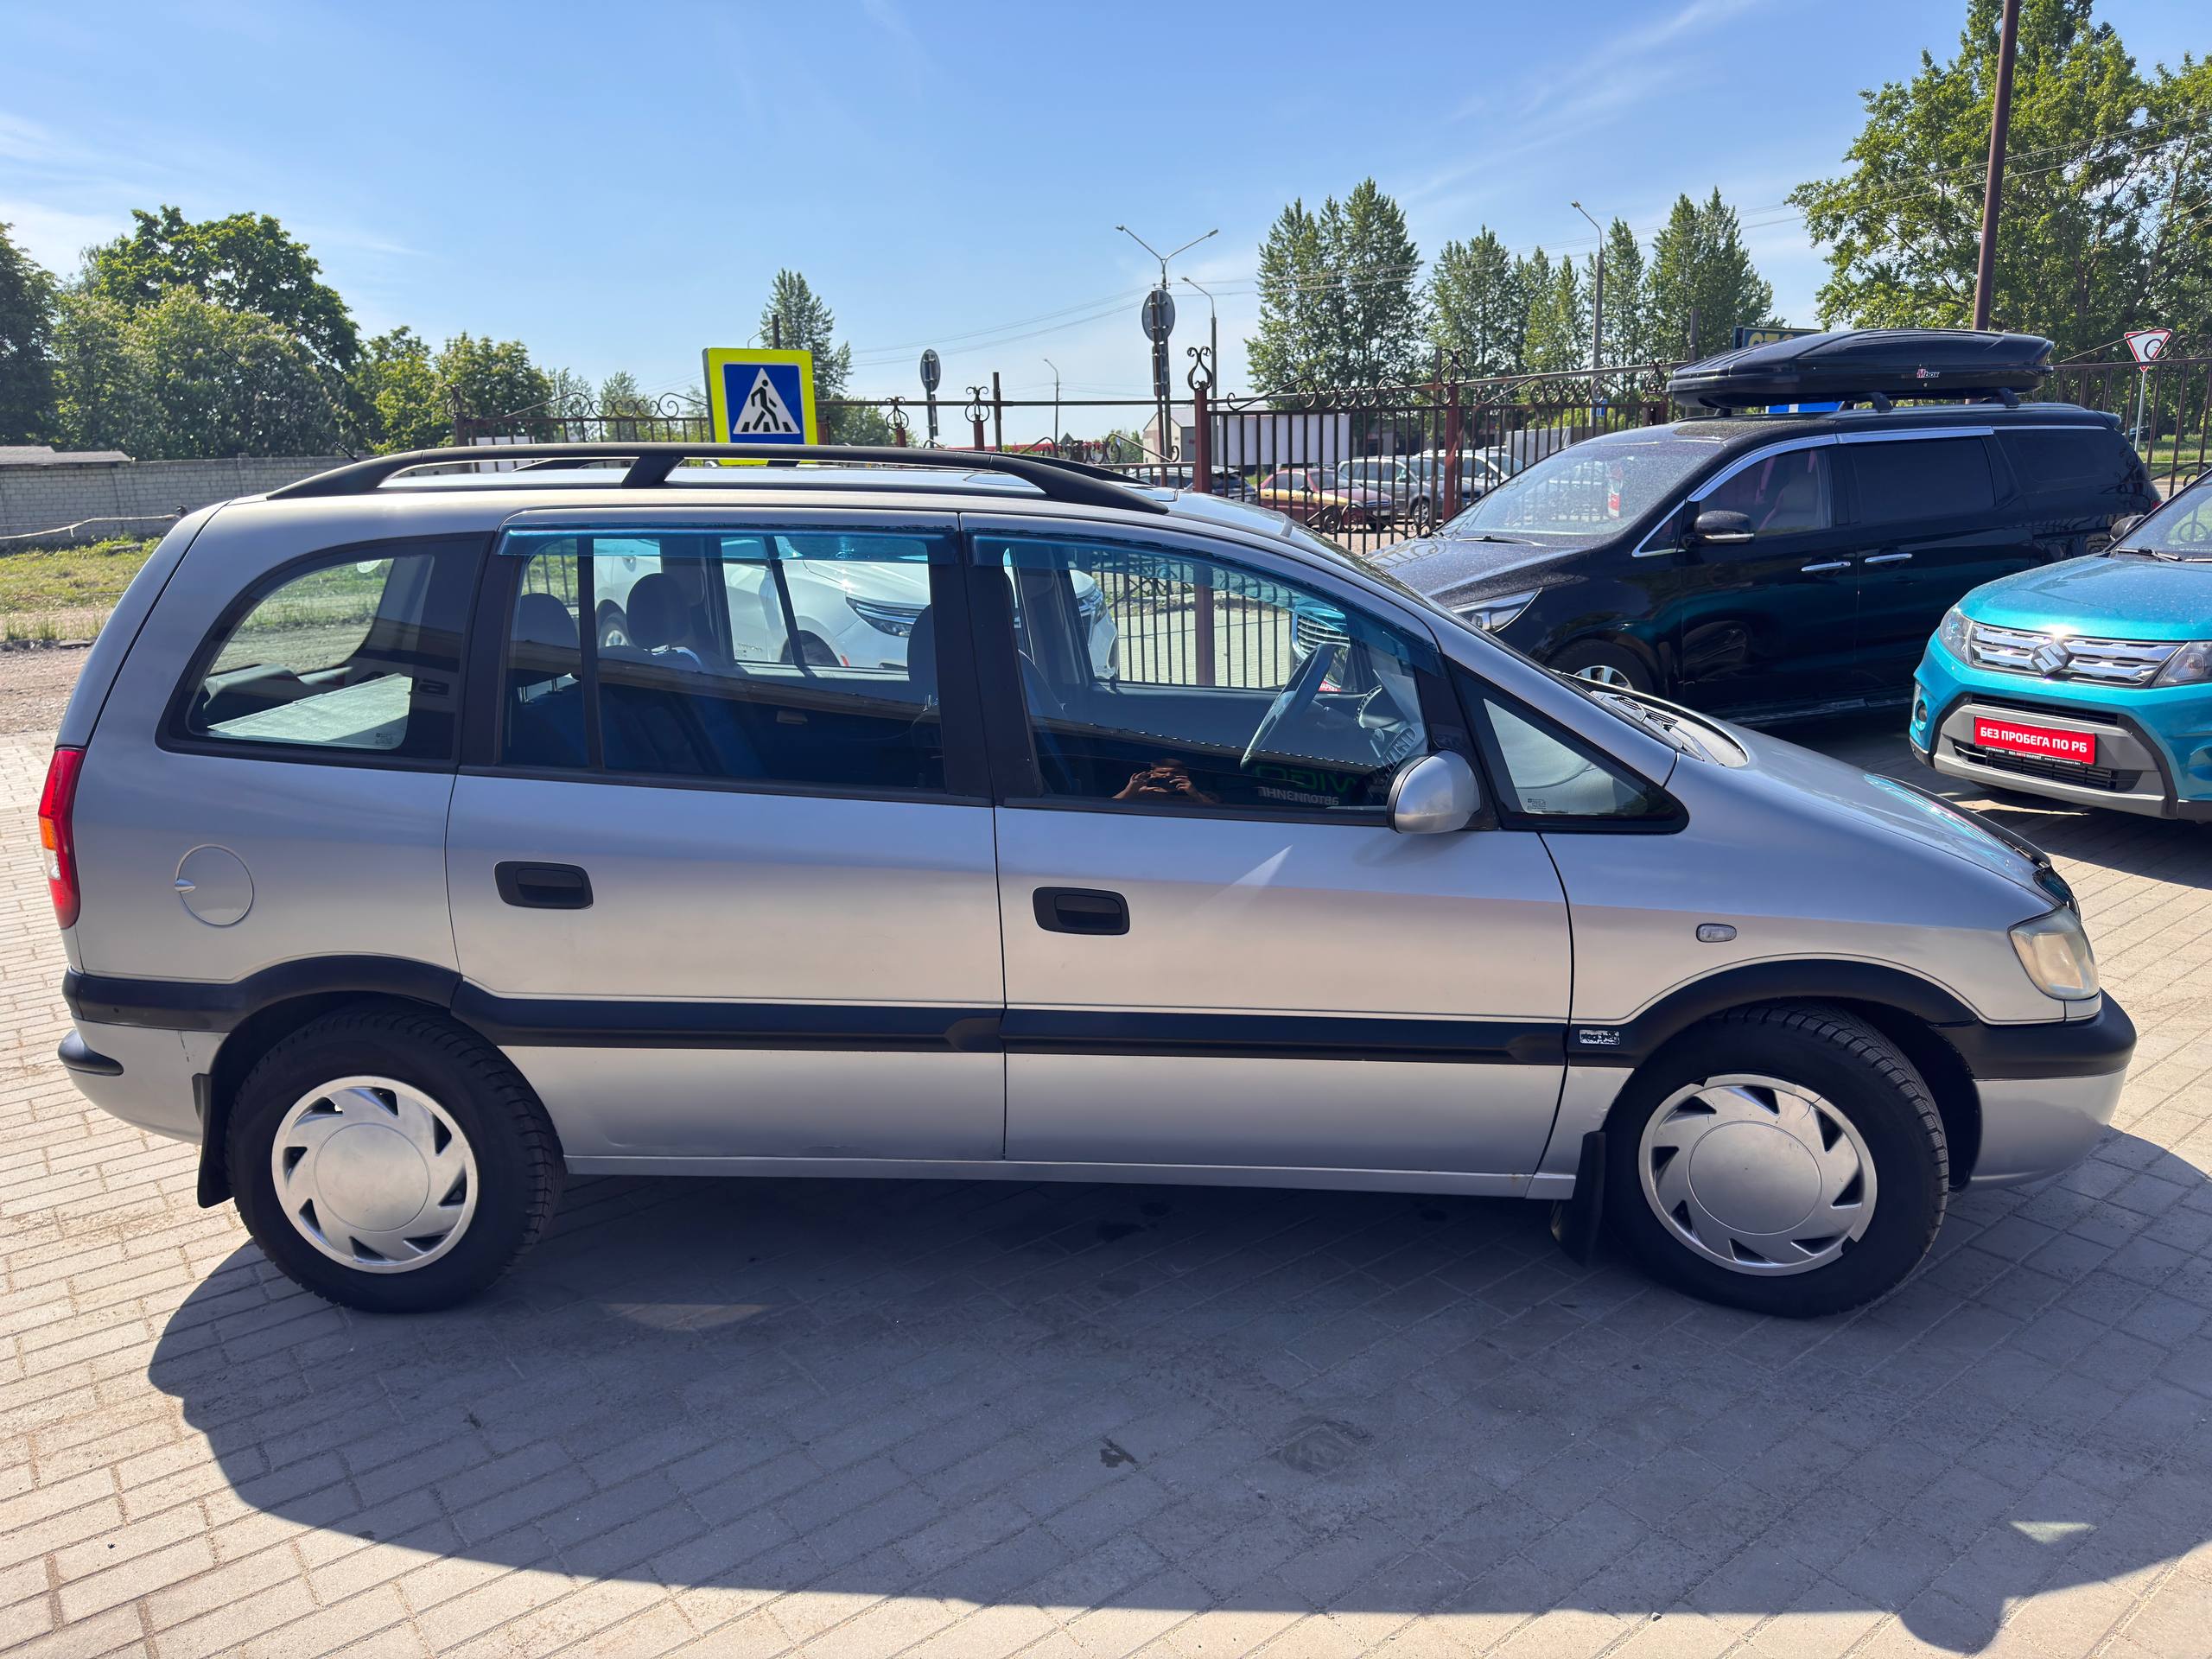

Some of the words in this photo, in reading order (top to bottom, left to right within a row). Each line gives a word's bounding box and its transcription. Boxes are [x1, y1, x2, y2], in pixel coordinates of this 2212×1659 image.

[1916, 368, 1940, 378] Mbox
[1980, 727, 1999, 739] БЕЗ
[2001, 730, 2050, 747] ПРОБЕГА
[2052, 738, 2069, 750] ПО
[2071, 741, 2088, 753] РБ
